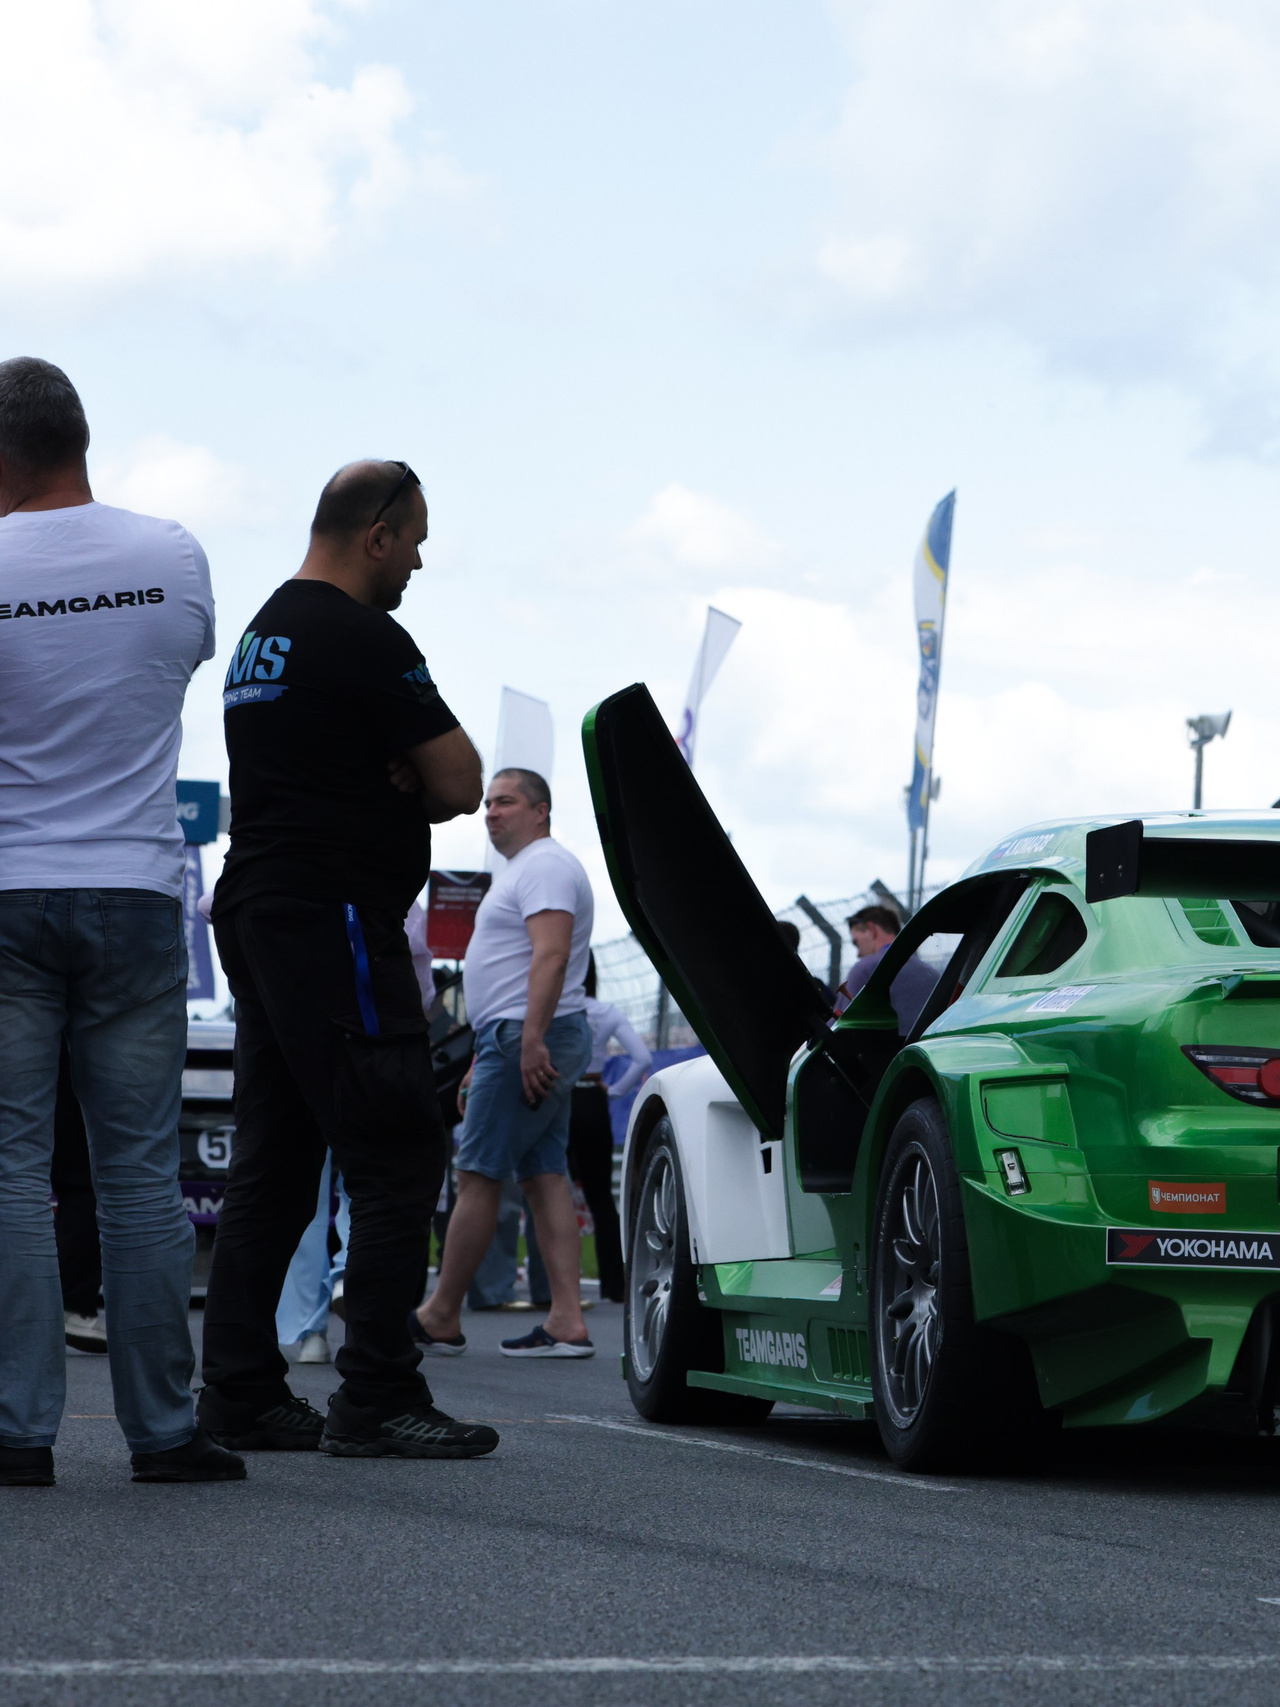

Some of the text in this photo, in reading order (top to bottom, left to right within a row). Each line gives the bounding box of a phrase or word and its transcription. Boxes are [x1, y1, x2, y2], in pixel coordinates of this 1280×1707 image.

[240, 688, 262, 700] TEAM
[1161, 1192, 1220, 1202] ЧЕМПИОНАТ
[1156, 1237, 1273, 1260] YOKOHAMA
[736, 1329, 808, 1369] TEAMGARIS
